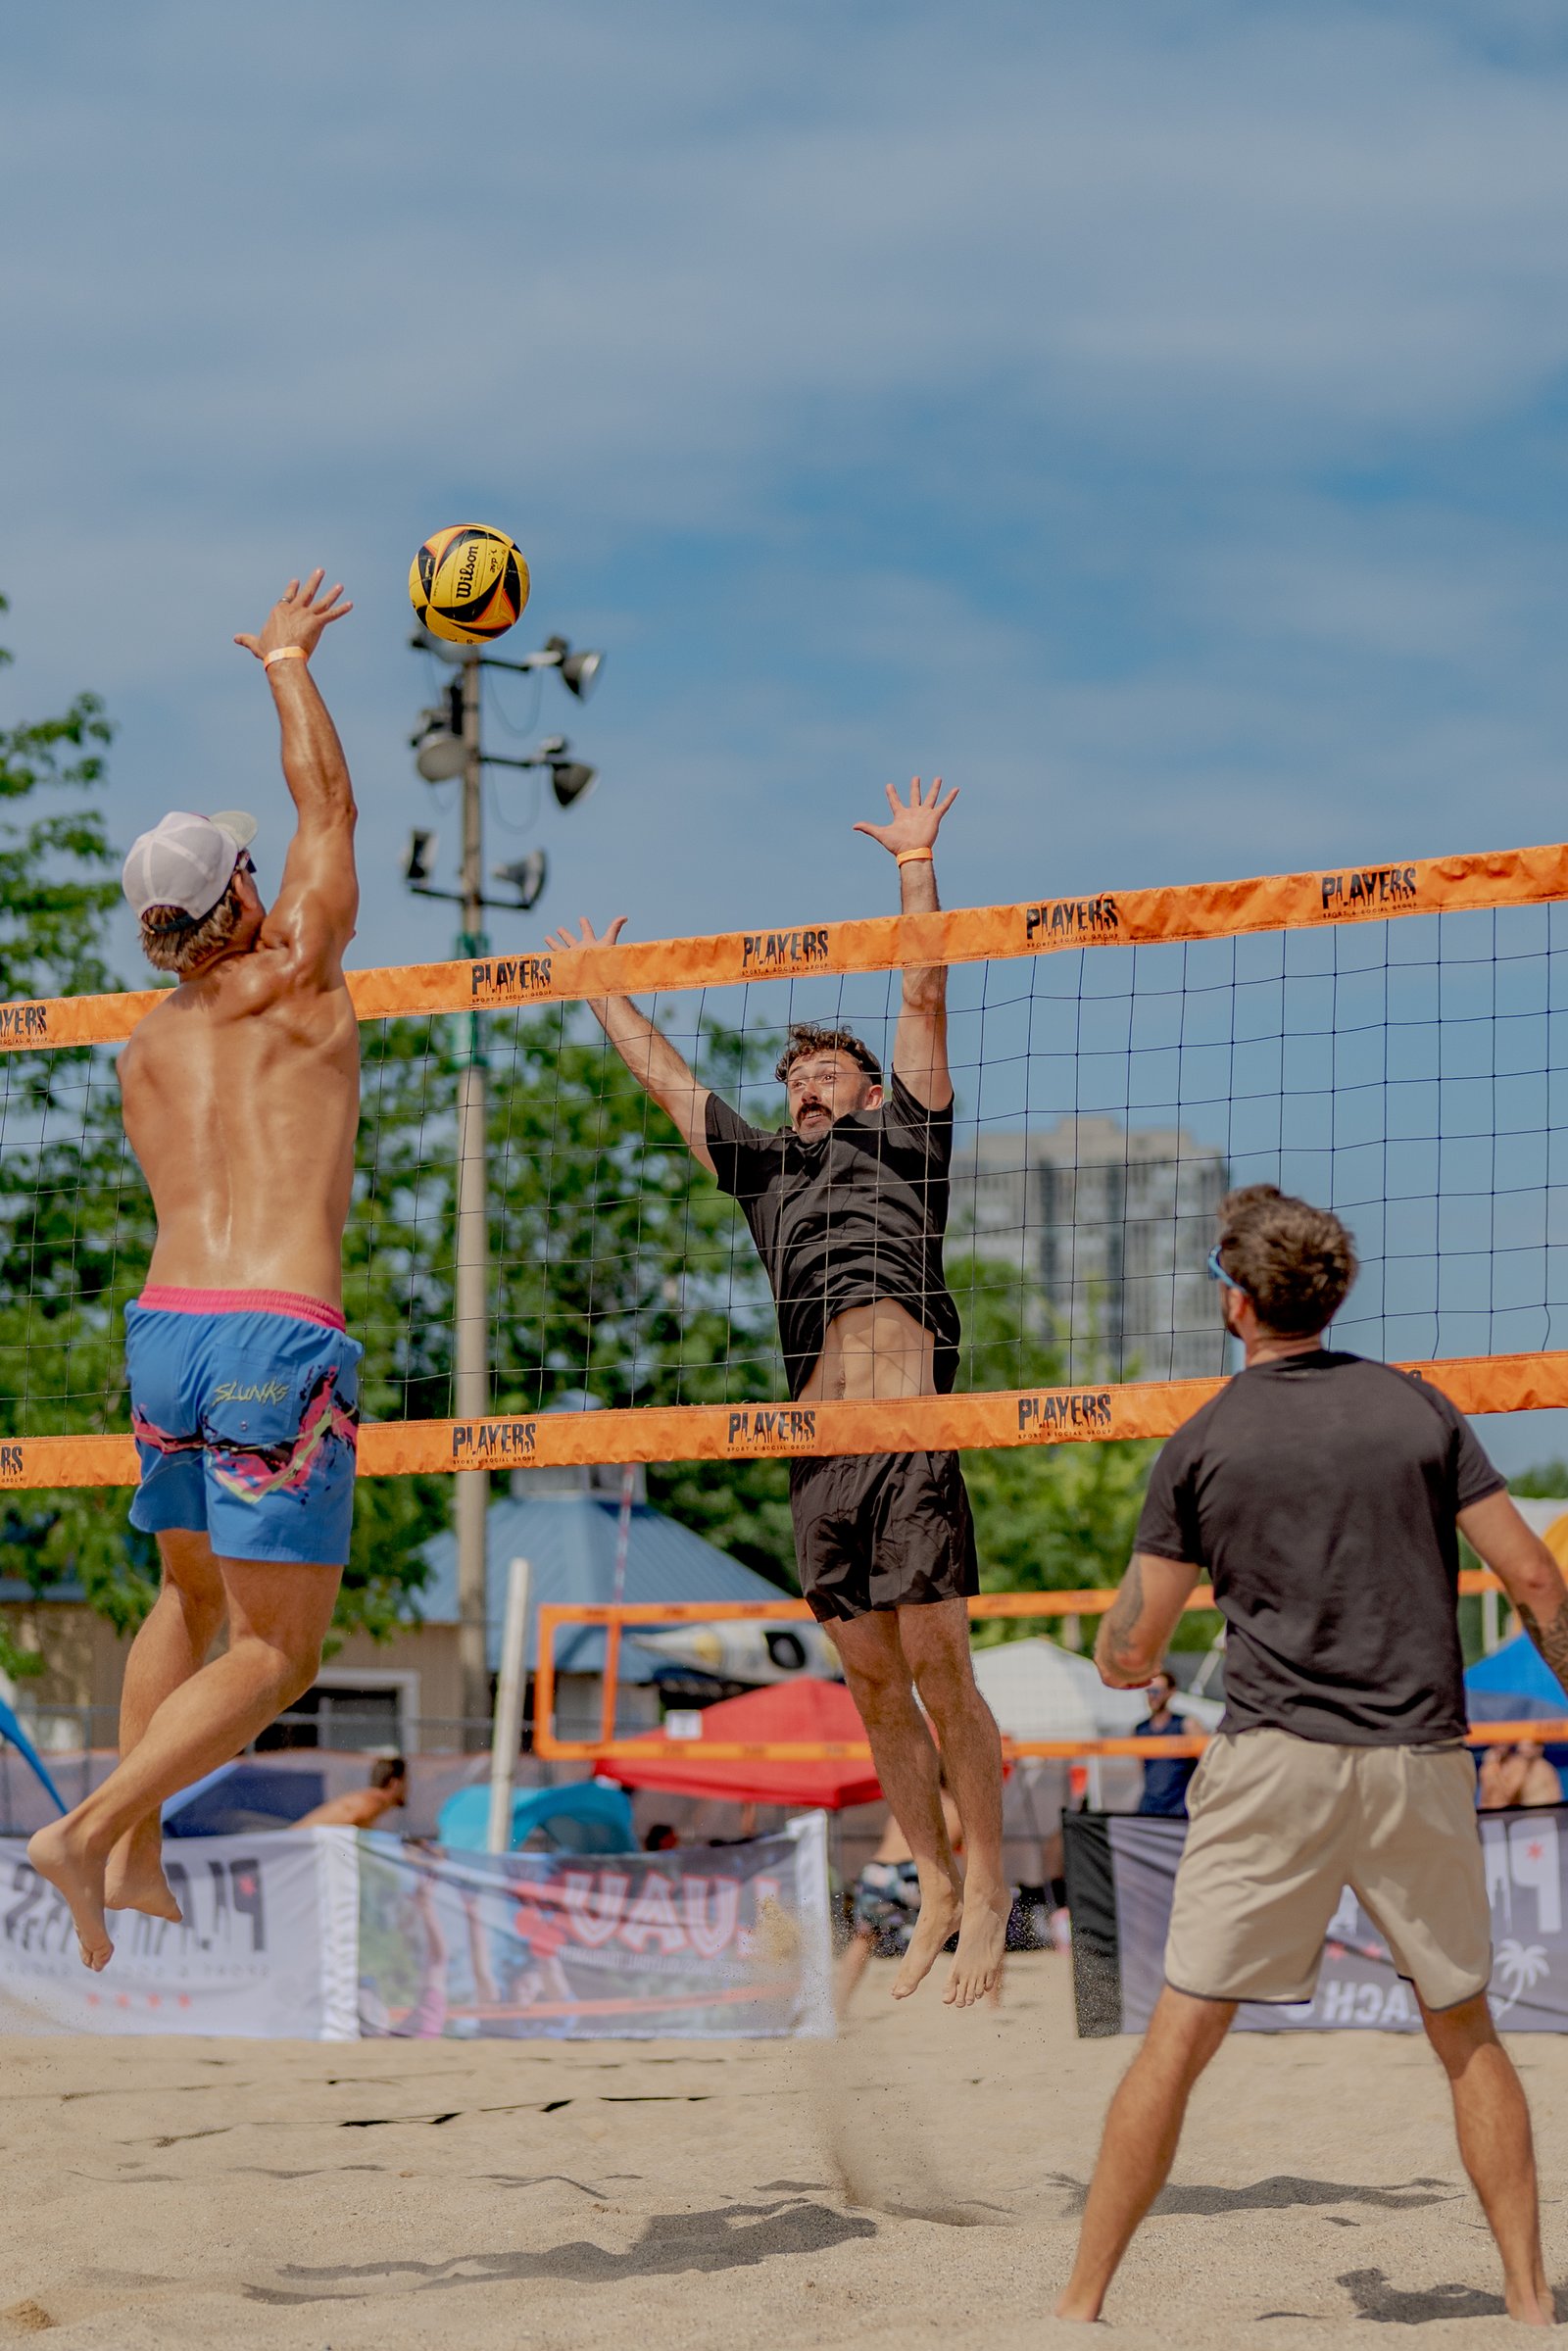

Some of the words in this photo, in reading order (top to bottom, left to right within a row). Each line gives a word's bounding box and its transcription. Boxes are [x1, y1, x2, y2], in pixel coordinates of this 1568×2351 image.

[456, 546, 478, 599] Wilson
[1321, 867, 1417, 909] PLAYERS
[1026, 899, 1118, 940] PLAYERS
[742, 930, 828, 967] PLAYERS
[471, 957, 552, 996] PLAYERS
[0, 1005, 47, 1037] YERS
[728, 1410, 815, 1444] PLAYERS
[1018, 1393, 1111, 1431] PLAYERS
[453, 1423, 536, 1457] PLAYERS
